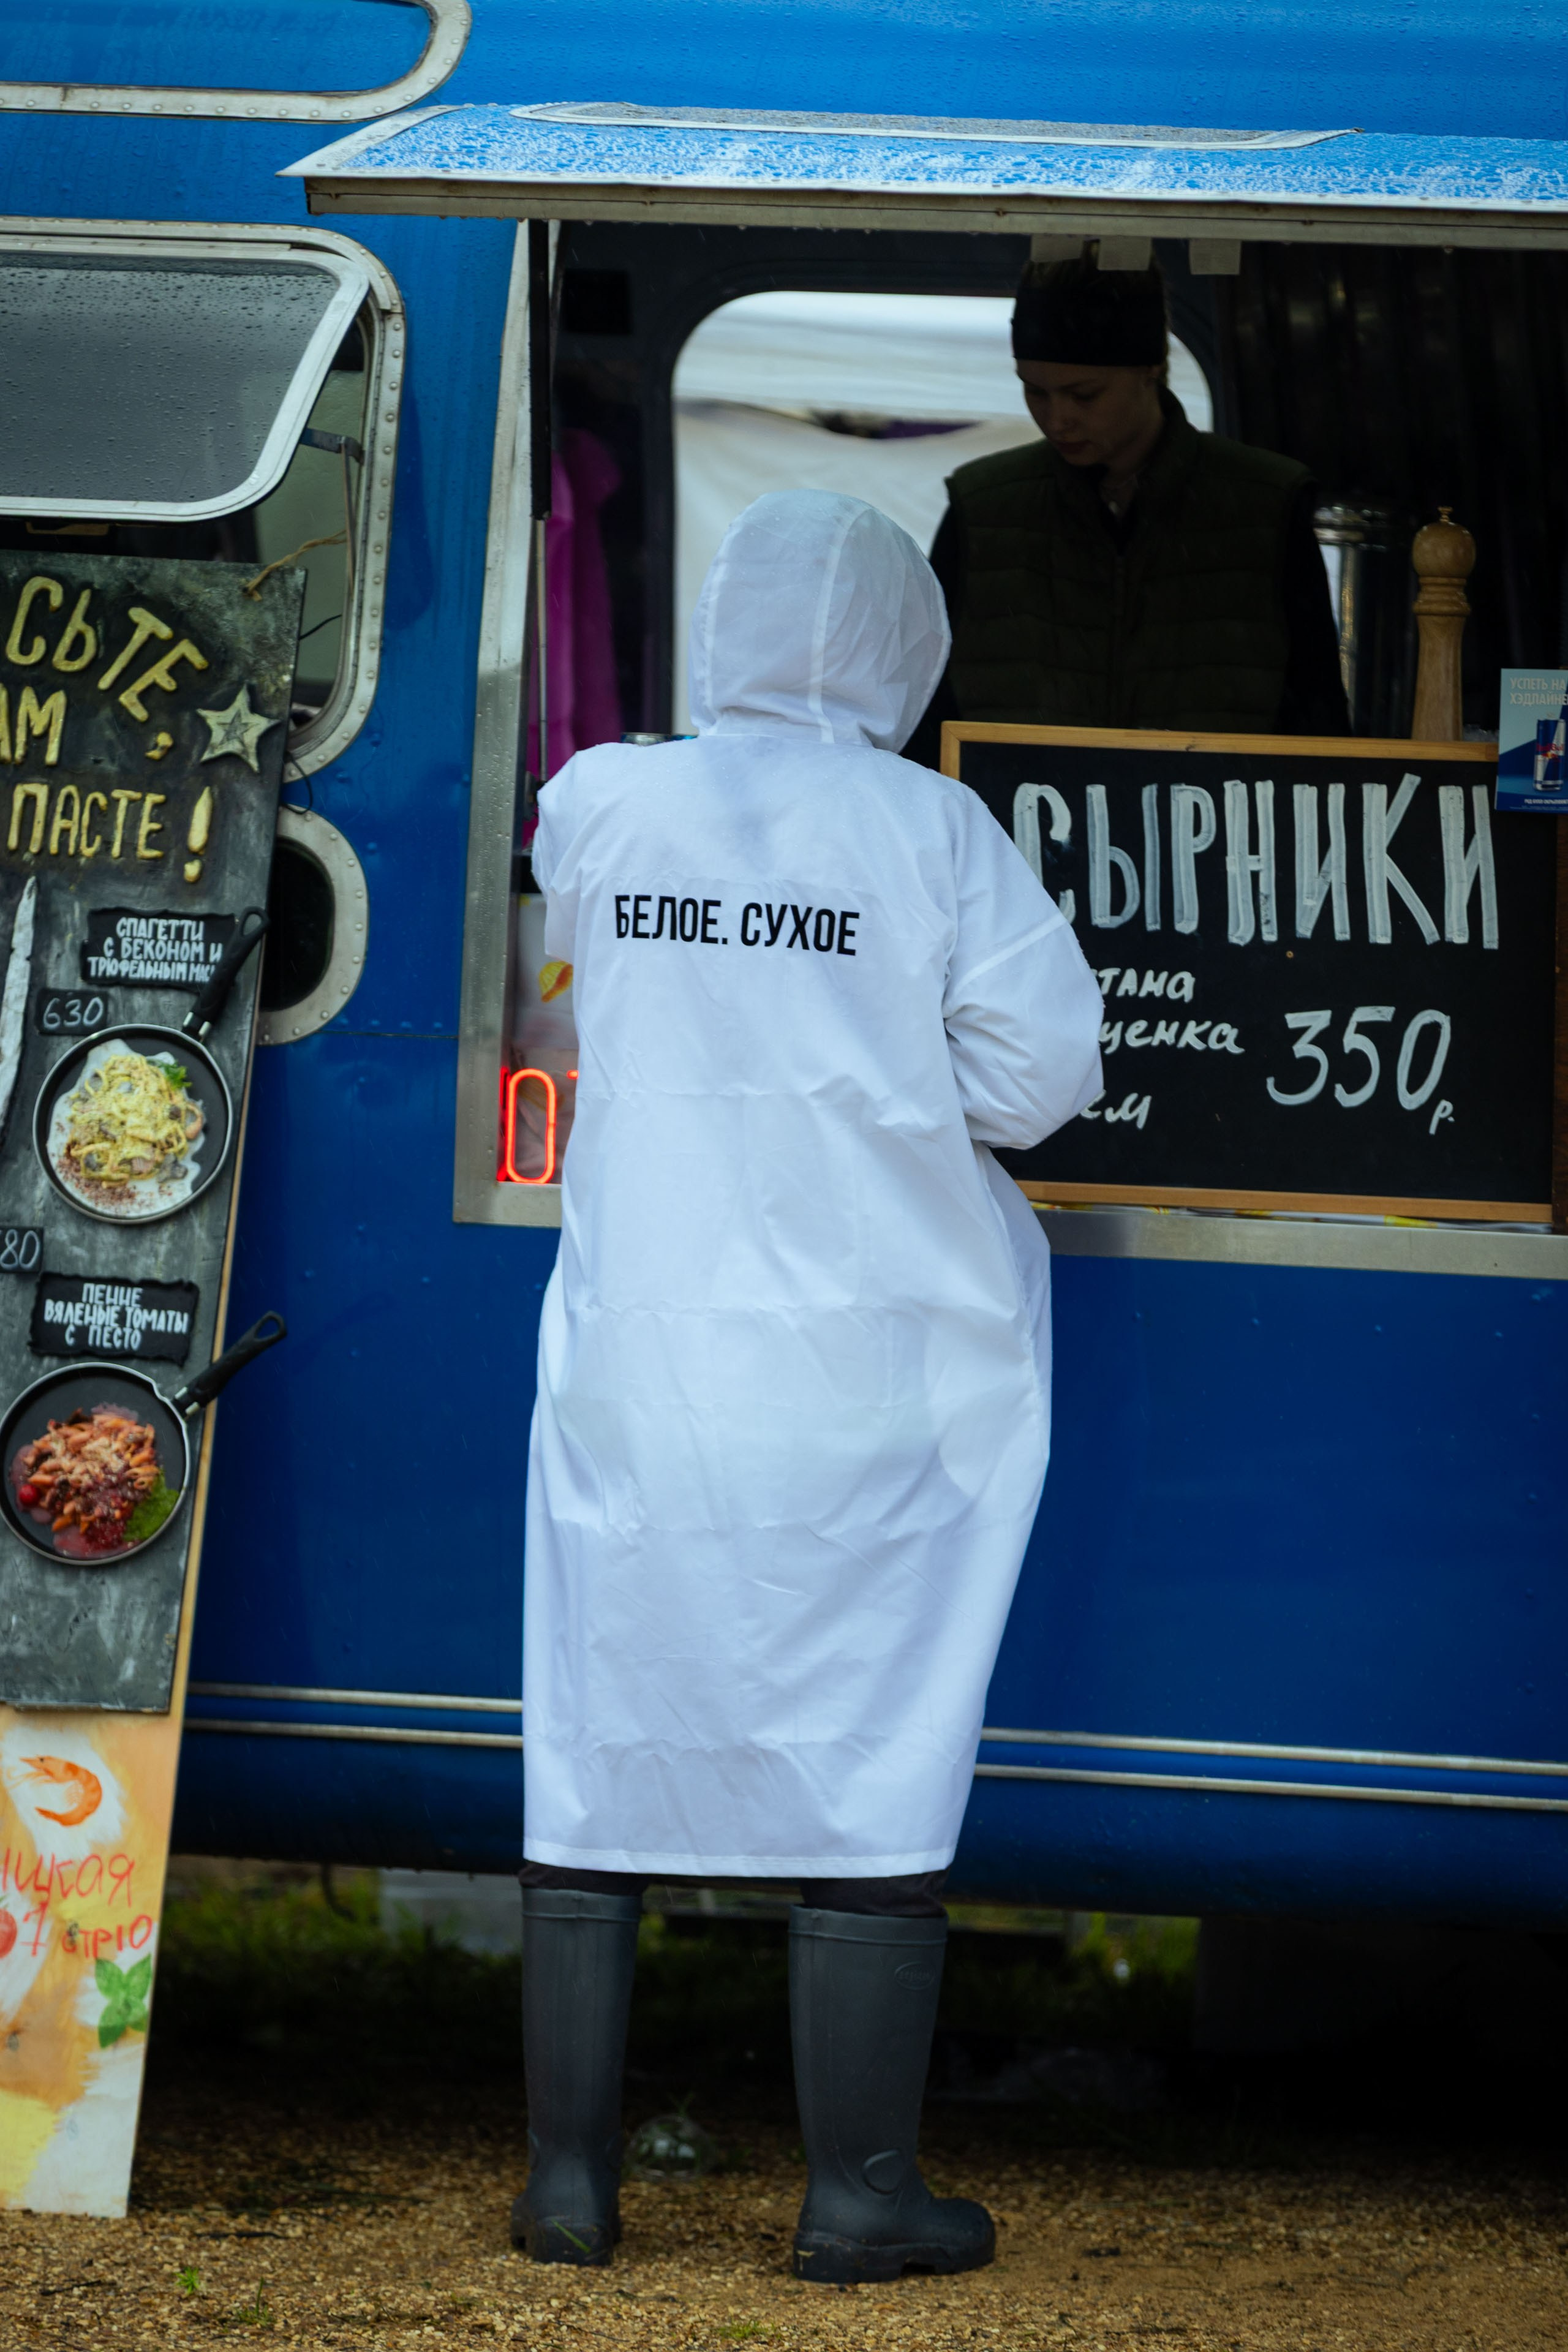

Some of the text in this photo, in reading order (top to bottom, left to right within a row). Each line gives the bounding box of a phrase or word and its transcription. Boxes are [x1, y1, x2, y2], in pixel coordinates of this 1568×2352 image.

[1510, 677, 1566, 691] УСПЕТЬ НА
[1510, 690, 1568, 707] ХЭДЛАЙНЕ
[1012, 773, 1499, 949] СЫРНИКИ
[116, 917, 205, 941] СПАГЕТТИ
[615, 894, 859, 956] БЕЛОЕ. СУХОЕ
[103, 937, 223, 963] С БЕКОНОМ И
[88, 956, 216, 982] ТРЮФЕЛЬНЫМ МАС
[43, 997, 104, 1030] 630
[1266, 1006, 1452, 1110] 350
[0, 1229, 40, 1270] 80
[81, 1283, 143, 1308] ПЕННЕ
[43, 1298, 189, 1334] ВЯЛЕНЫЕ ТОМАТЫ
[88, 1325, 142, 1351] ПЕСТО
